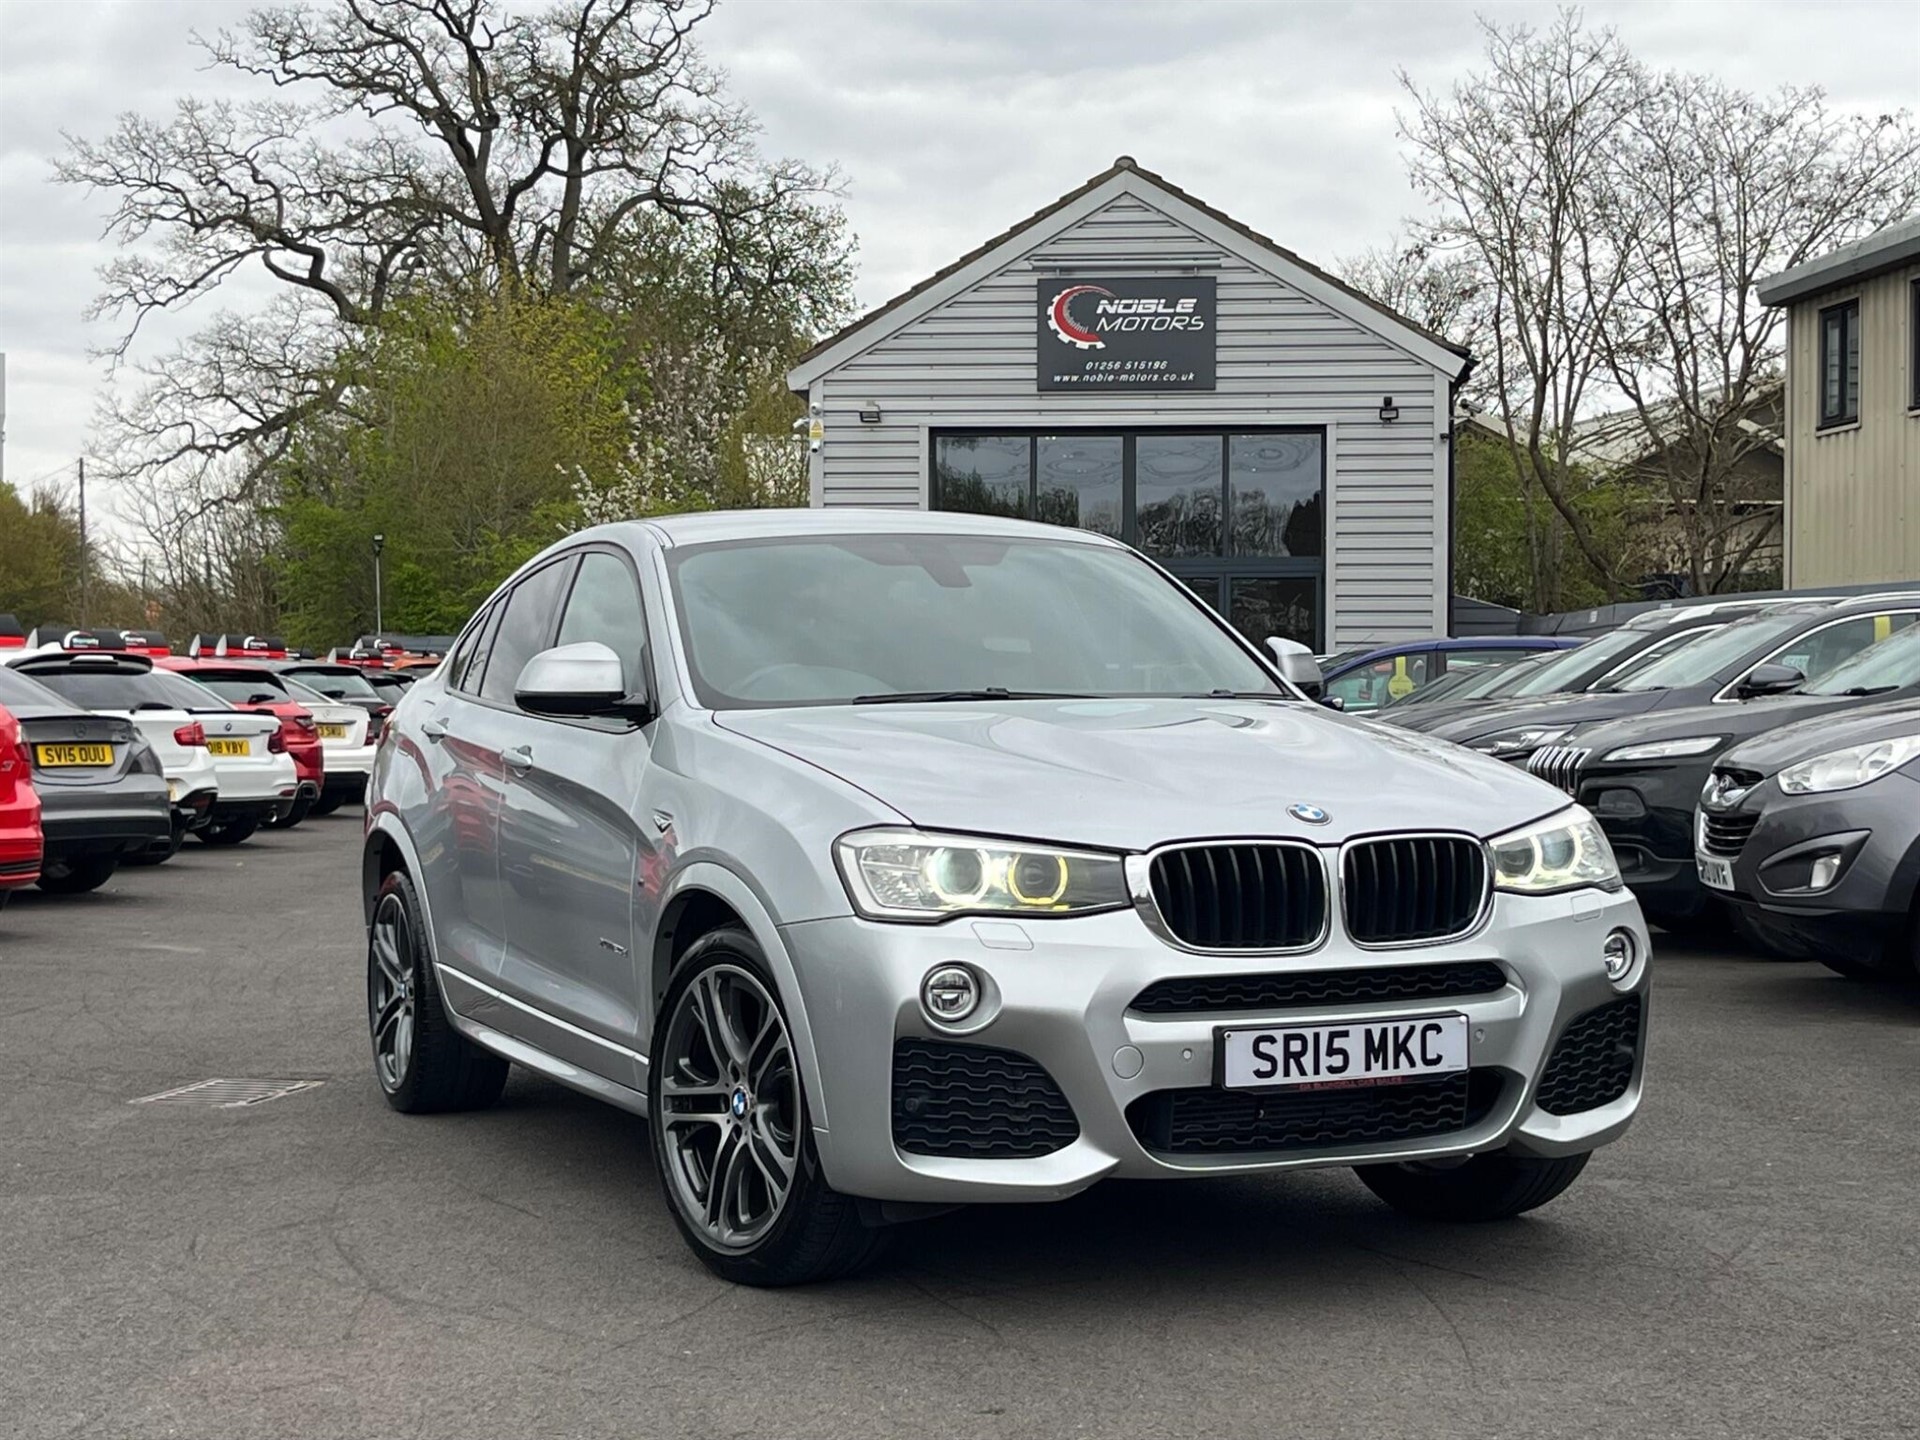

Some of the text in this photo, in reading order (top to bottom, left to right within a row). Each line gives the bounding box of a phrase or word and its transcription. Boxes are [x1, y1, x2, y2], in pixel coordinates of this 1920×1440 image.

[1096, 298, 1198, 314] NOBLE
[1096, 315, 1205, 332] MOTORS
[1085, 360, 1168, 371] 01256 515196
[1053, 371, 1196, 383] www.noble-motors.co.uk
[45, 746, 76, 763] SV15
[1252, 1023, 1443, 1079] SR15 MKC
